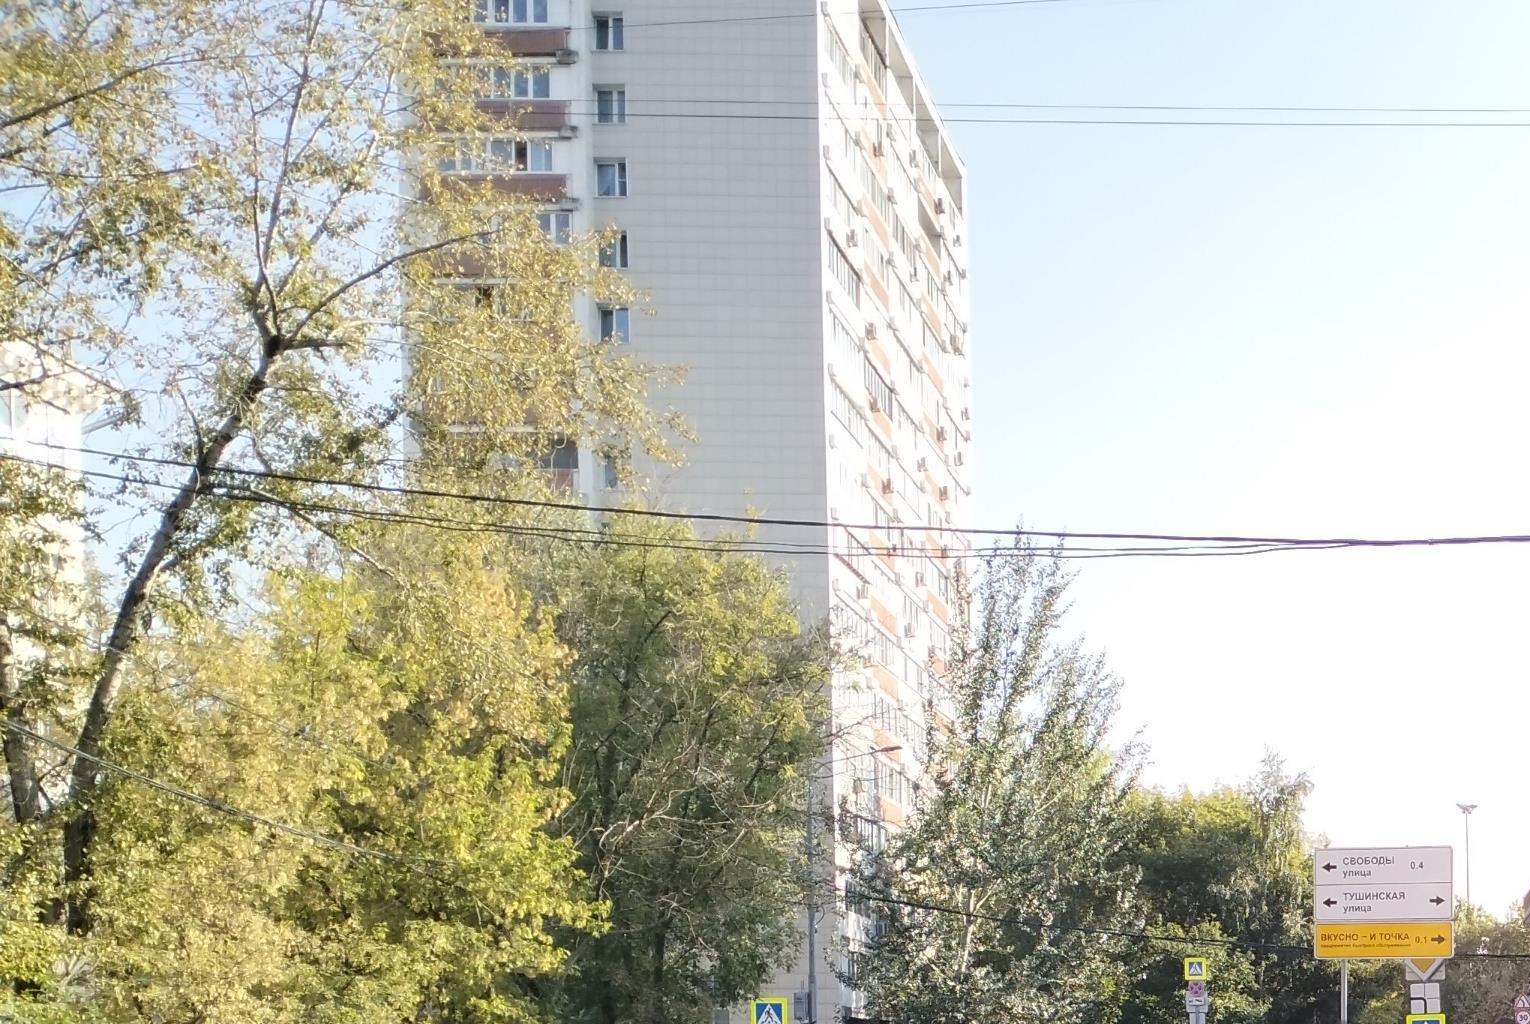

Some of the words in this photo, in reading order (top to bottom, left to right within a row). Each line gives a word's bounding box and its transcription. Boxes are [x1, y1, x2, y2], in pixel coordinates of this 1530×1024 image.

[1342, 856, 1395, 866] СВОБОДЫ
[1410, 861, 1424, 870] 0.4
[1343, 869, 1372, 879] улица
[1343, 891, 1406, 901] ТУШИНСКАЯ
[1343, 904, 1372, 914] улица
[1320, 933, 1359, 942] ВКУСНО
[1369, 933, 1376, 941] И
[1379, 932, 1410, 941] ТОЧКА
[1415, 936, 1428, 944] 0.1
[1519, 1014, 1529, 1022] 30
